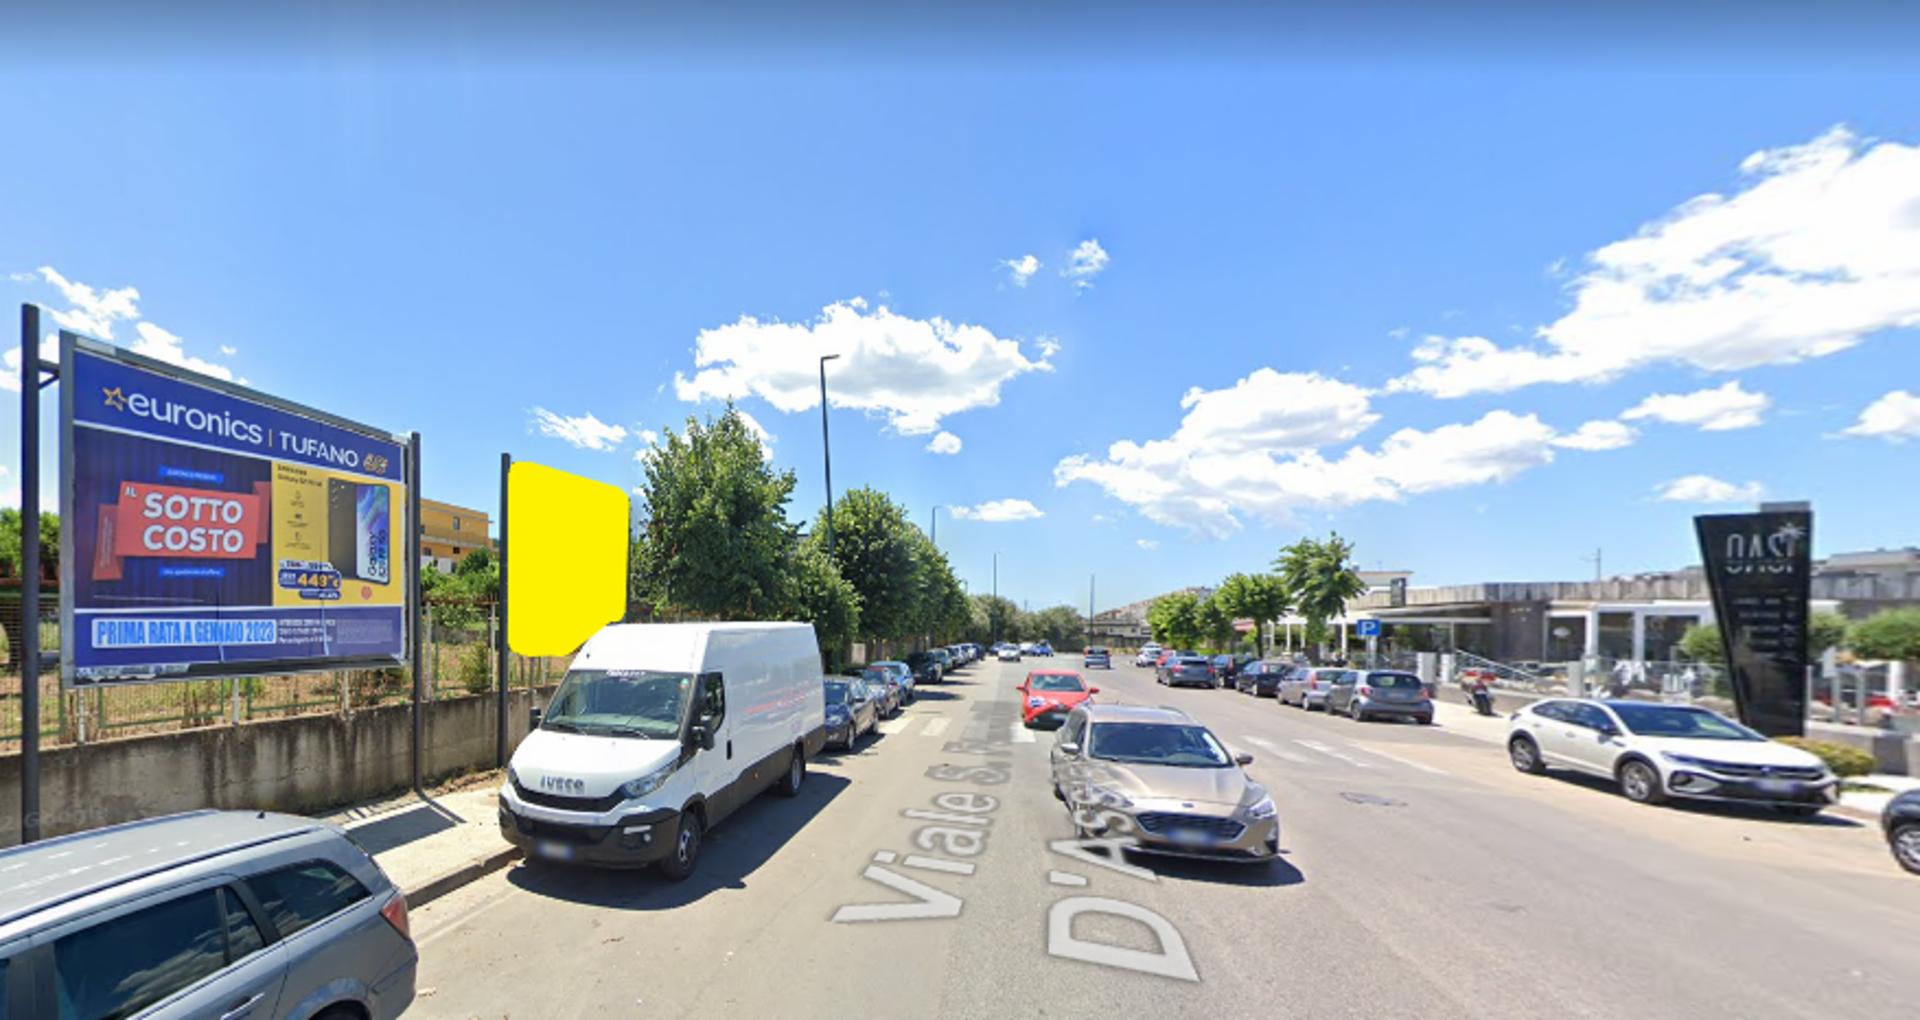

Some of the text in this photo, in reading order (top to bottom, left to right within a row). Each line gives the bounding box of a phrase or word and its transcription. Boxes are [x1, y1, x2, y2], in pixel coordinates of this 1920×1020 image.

[127, 392, 263, 445] euronics
[279, 430, 359, 468] TUFANO
[143, 492, 244, 524] SOTTO
[143, 524, 244, 553] COSTO
[98, 621, 146, 644] PRIMA
[150, 621, 181, 644] RATA
[183, 621, 192, 644] A
[1361, 621, 1376, 635] P
